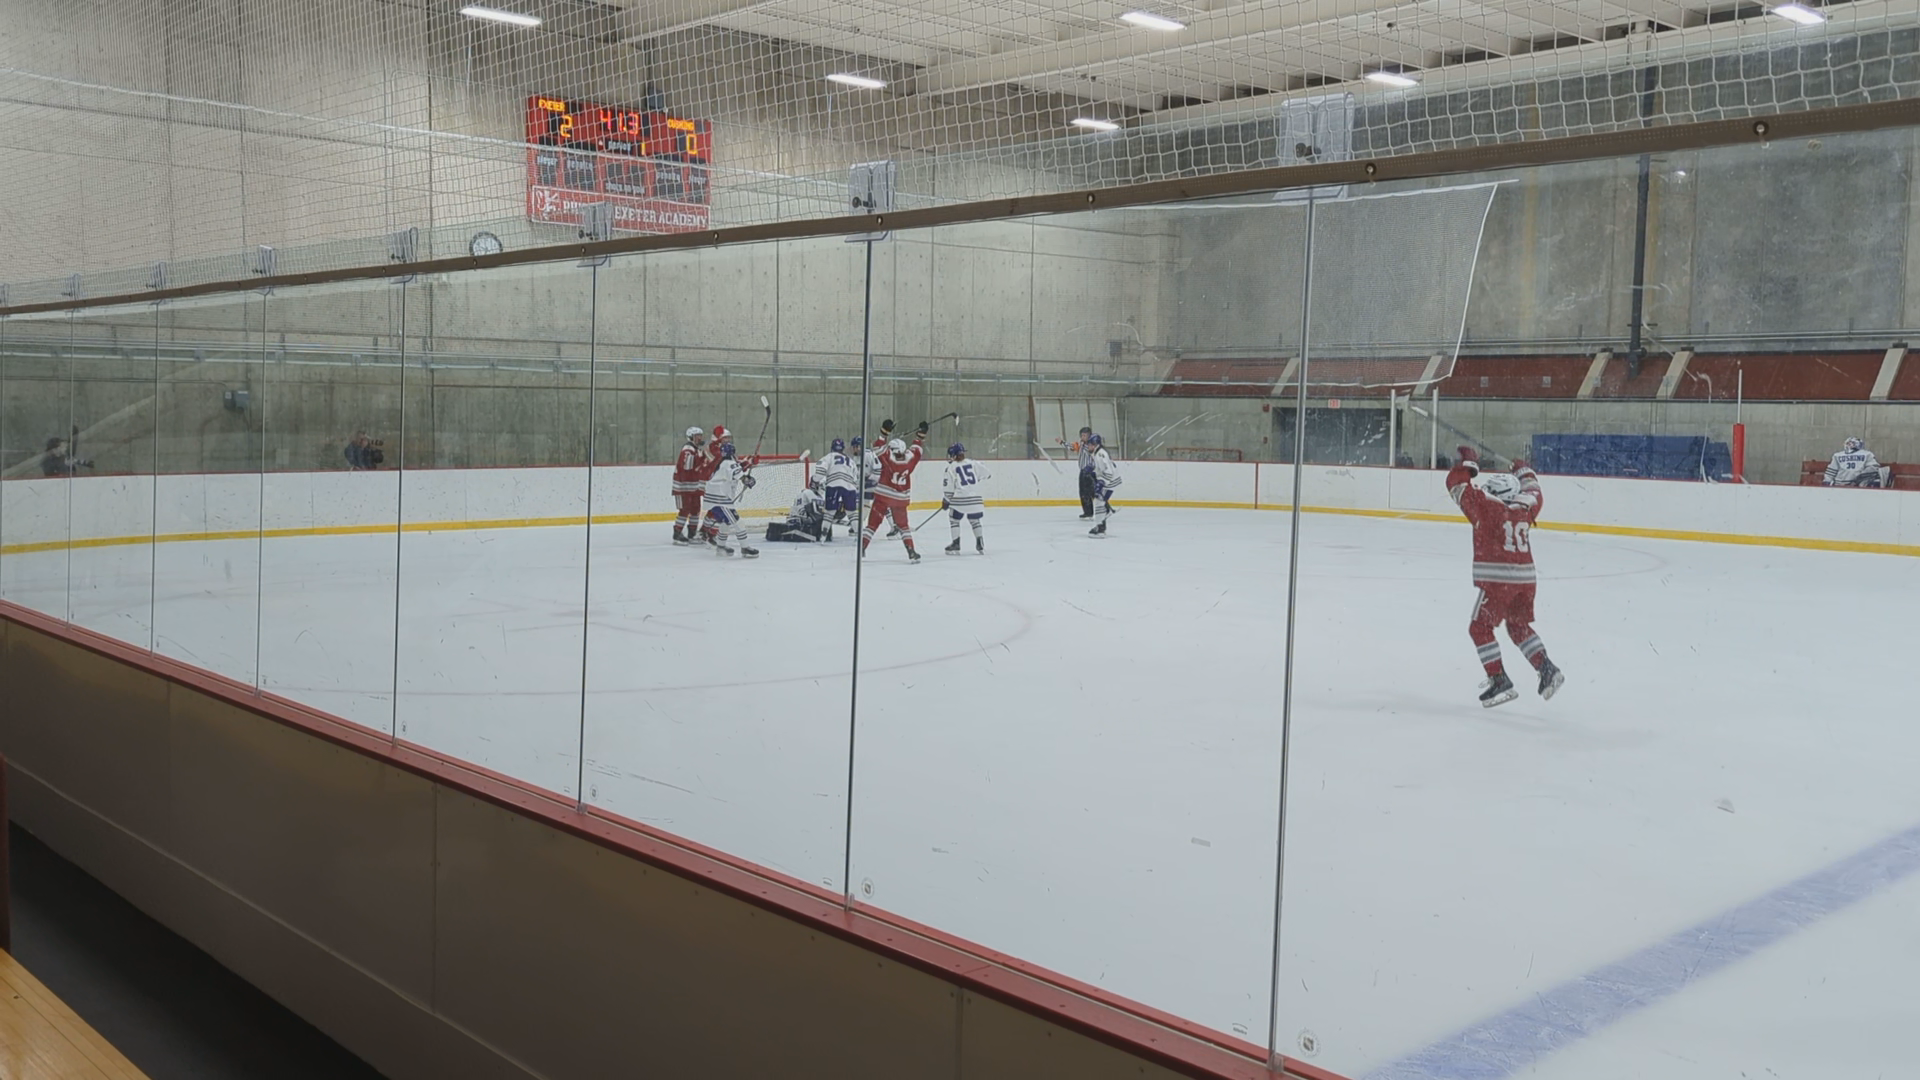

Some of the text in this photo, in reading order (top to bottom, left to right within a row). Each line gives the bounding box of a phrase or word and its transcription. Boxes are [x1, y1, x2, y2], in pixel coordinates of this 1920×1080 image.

[560, 114, 572, 137] 2
[641, 142, 646, 156] 1
[686, 133, 698, 154] 0
[614, 205, 707, 228] EXETER ACADEMY
[955, 464, 976, 486] 15
[1503, 520, 1529, 552] 10
